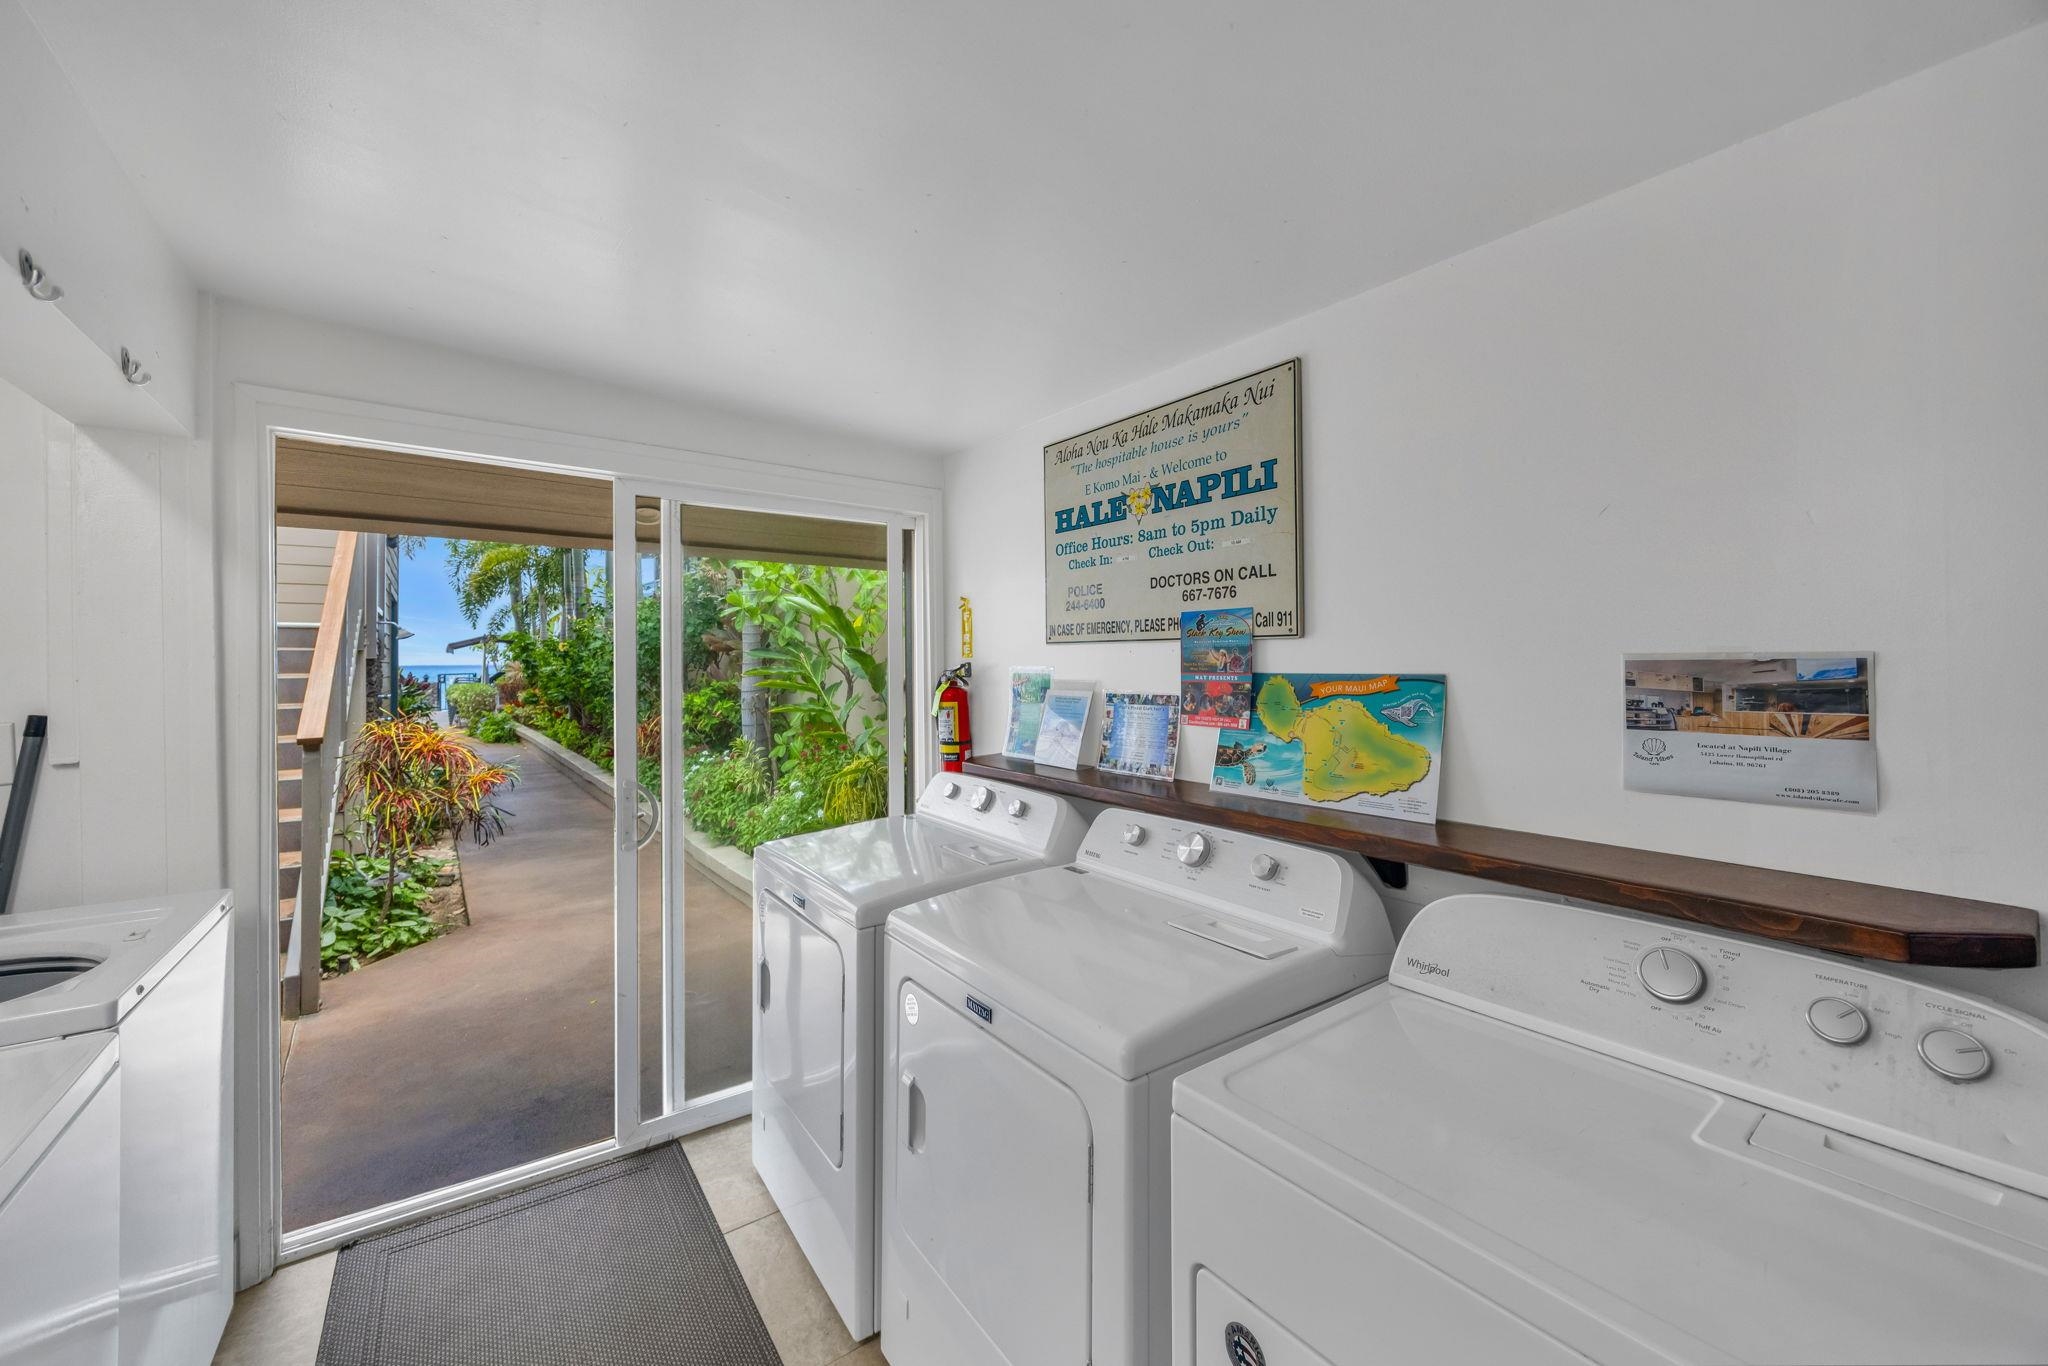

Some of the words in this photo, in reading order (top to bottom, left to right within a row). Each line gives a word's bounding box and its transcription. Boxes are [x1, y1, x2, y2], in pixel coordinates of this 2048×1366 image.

[1054, 442, 1083, 465] Aloha
[1086, 435, 1109, 456] Nou
[1112, 429, 1128, 447] Ka
[1131, 416, 1158, 441] Hale
[1161, 391, 1239, 431] Makamaka
[1243, 378, 1276, 406] Nui
[1095, 445, 1148, 470] hospitable
[1150, 435, 1184, 453] house
[1188, 430, 1198, 443] is
[1085, 484, 1091, 495] E
[1093, 480, 1120, 494] Komo
[1122, 471, 1141, 486] Mai
[1149, 466, 1158, 479] &
[1161, 453, 1212, 475] Welcome
[1215, 450, 1227, 462] to
[1055, 494, 1127, 534] HALE
[1150, 458, 1278, 514] NAPILI
[1055, 541, 1088, 557] Office
[1091, 534, 1134, 551] Hours:
[1137, 527, 1168, 542] 8am
[1171, 522, 1186, 537] to
[1191, 516, 1226, 537] 5pm
[1231, 505, 1278, 527] Daily
[1148, 543, 1184, 559] Check
[1187, 540, 1214, 553] Out:
[1068, 556, 1096, 570] Check
[1099, 555, 1113, 566] In:
[1150, 571, 1210, 589] DOCTORS
[1213, 568, 1234, 583] ON
[1238, 563, 1277, 580] CALL
[1067, 583, 1103, 598] POLICE
[1182, 585, 1237, 602] 667-7676
[1065, 598, 1105, 612] 244-6400
[1049, 625, 1056, 636] IN
[1057, 624, 1074, 636] CASE
[1075, 622, 1085, 635] OF
[1086, 620, 1133, 635] EMERGENCY,
[1134, 618, 1166, 633] PLEASE
[1255, 611, 1274, 628] Call
[1277, 610, 1293, 626] 911
[1320, 685, 1343, 694] YOUR
[1345, 684, 1367, 693] MAUI
[1368, 679, 1388, 690] MAP
[1697, 742, 1726, 750] Located
[1764, 746, 1792, 754] Village
[1633, 752, 1654, 762] Island
[1719, 948, 1741, 958] Timed
[1722, 954, 1736, 962] Dry
[1407, 957, 1450, 977] Whirlpool
[1580, 979, 1610, 991] Automatic
[1815, 974, 1868, 990] TEMPERATURE
[1925, 1002, 1953, 1013] CYCLE
[1953, 1008, 1987, 1021] SIGNAL
[1694, 1022, 1711, 1031] Fluff
